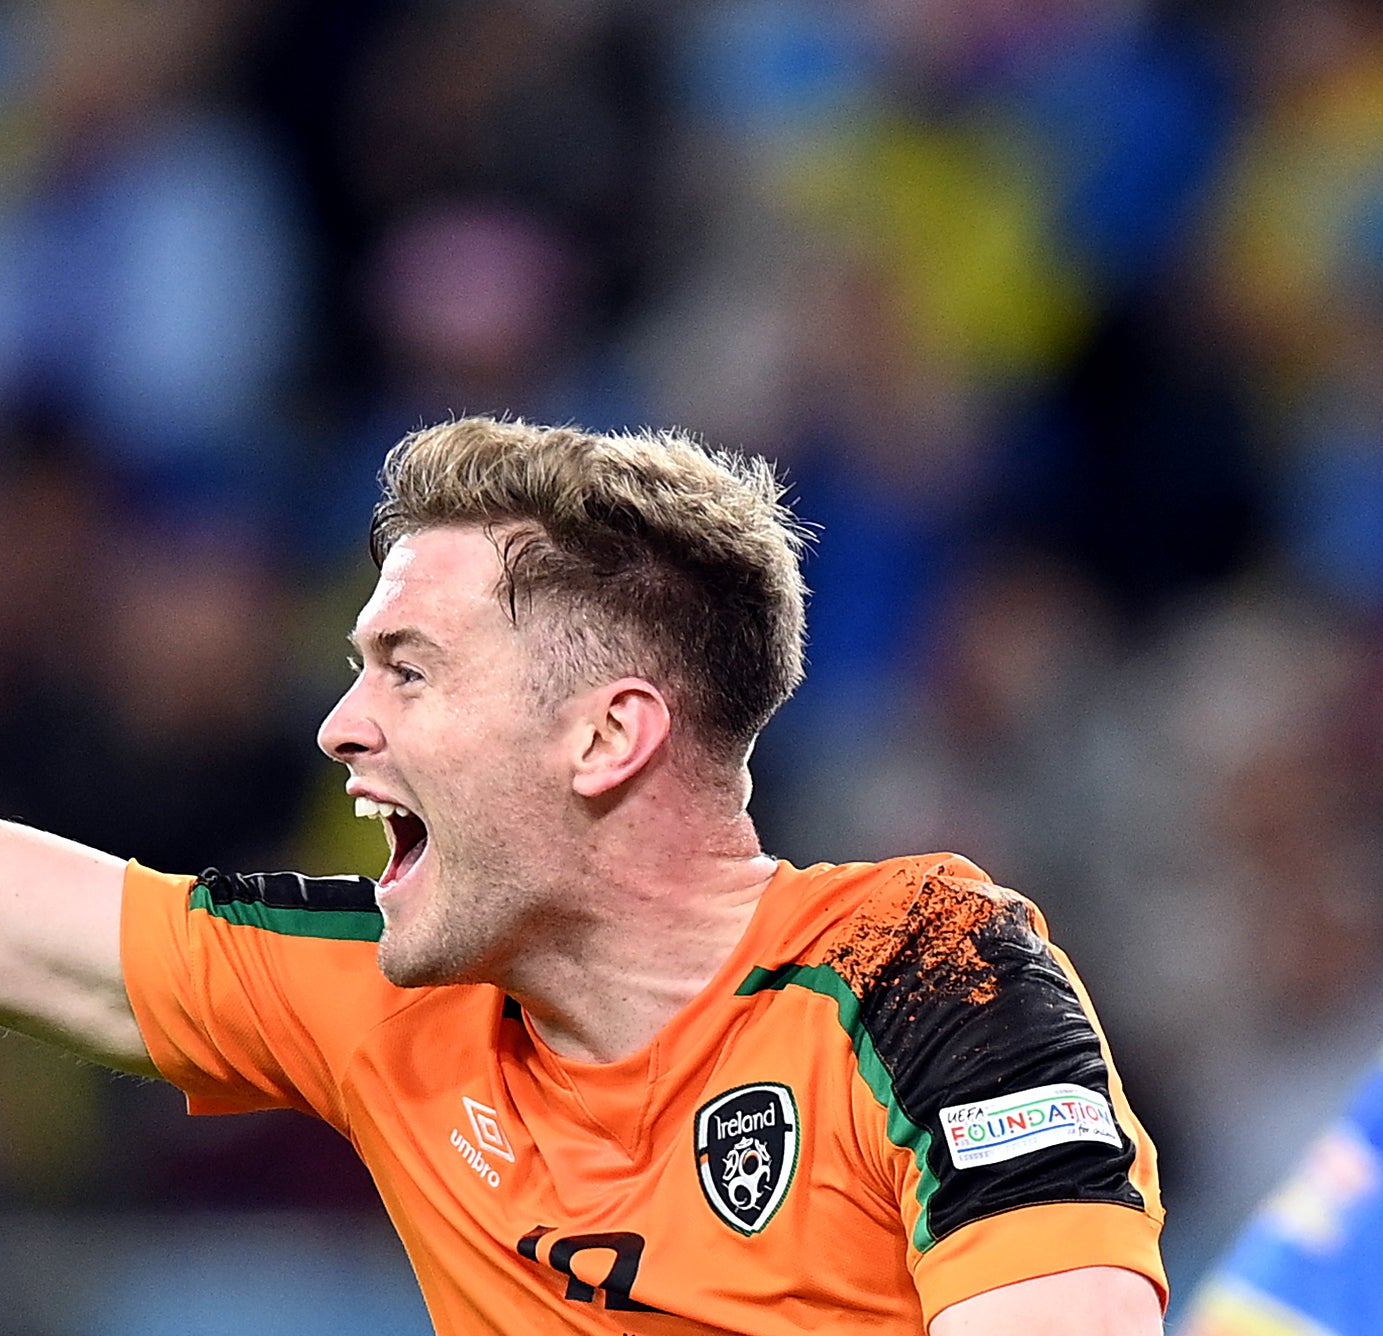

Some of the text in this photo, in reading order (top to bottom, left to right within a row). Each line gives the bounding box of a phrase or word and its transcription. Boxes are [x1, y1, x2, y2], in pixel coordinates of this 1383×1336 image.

[714, 1102, 775, 1140] Ireland
[947, 1107, 985, 1124] UEFA
[951, 1102, 1109, 1146] FOUNDATION
[450, 1128, 500, 1187] umbro
